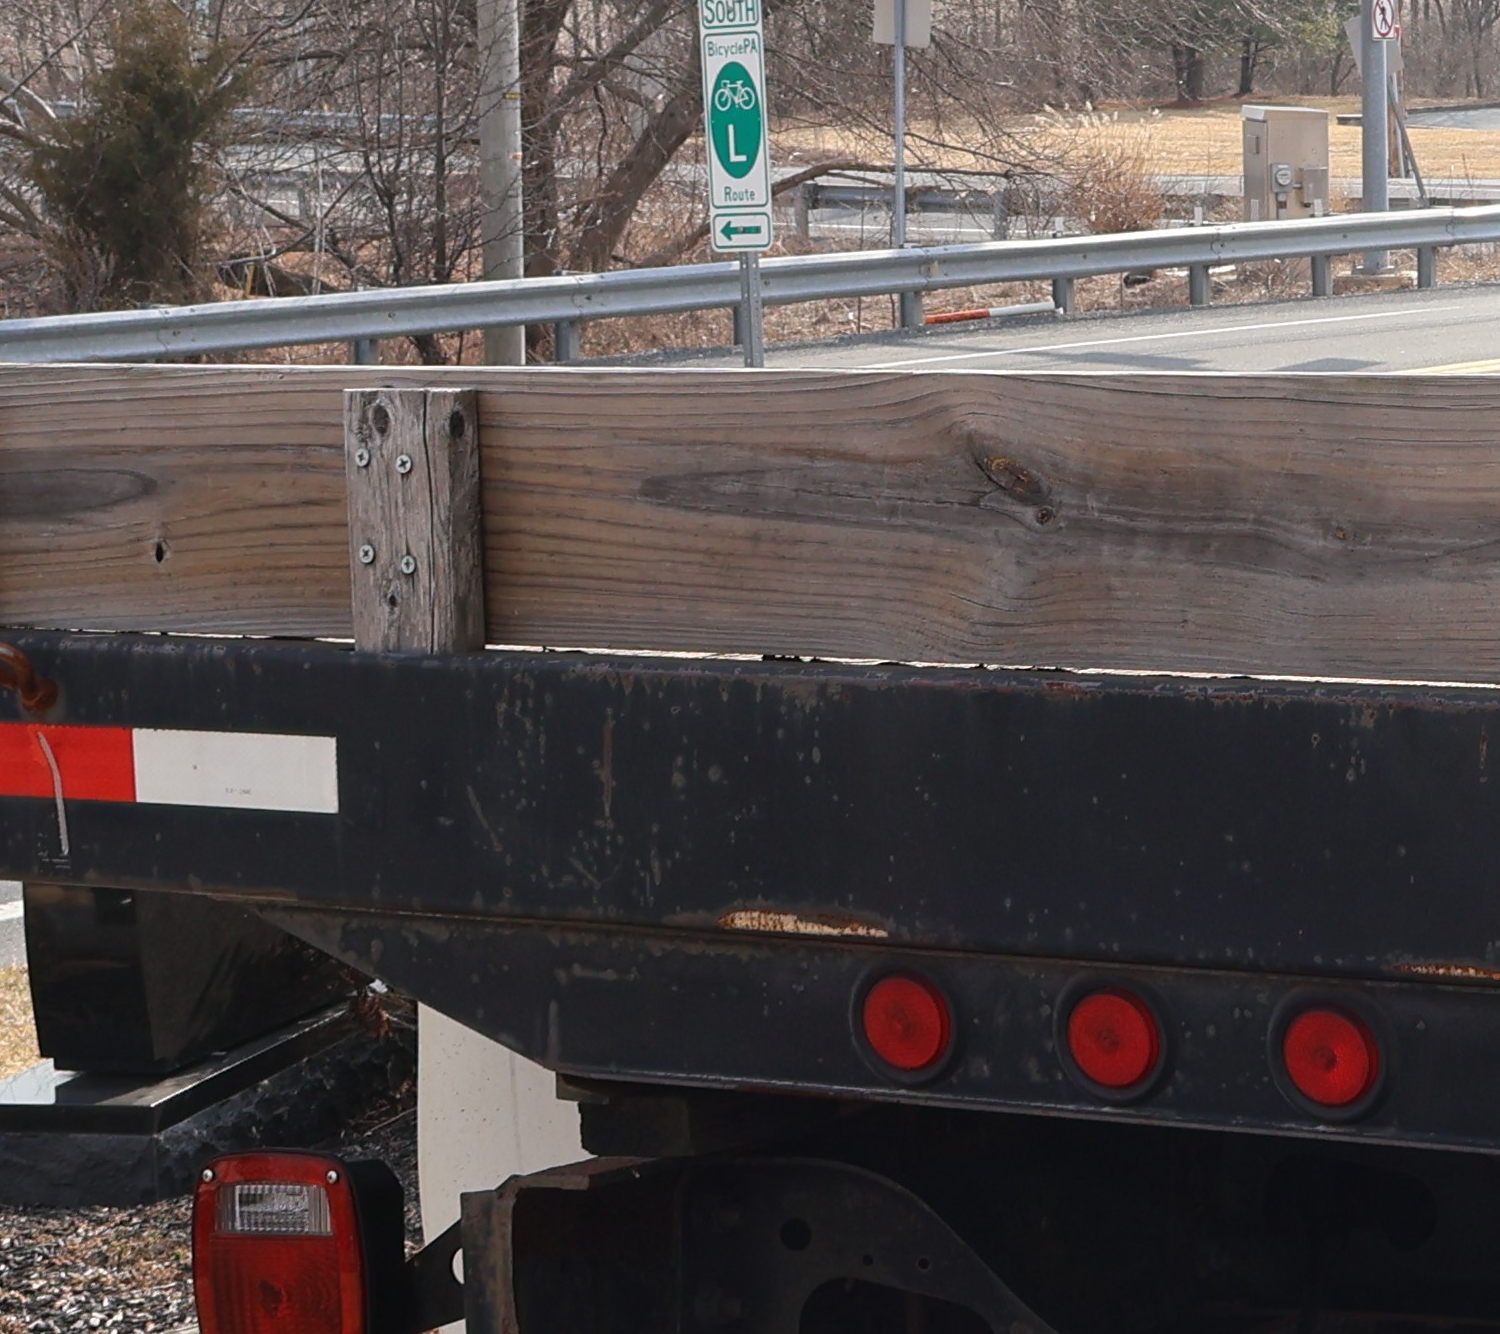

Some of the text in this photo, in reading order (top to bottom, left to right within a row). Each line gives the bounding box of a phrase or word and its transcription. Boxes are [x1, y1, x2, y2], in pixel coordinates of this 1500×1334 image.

[707, 37, 758, 58] BicyclePA
[727, 124, 747, 163] L
[724, 186, 756, 202] Route
